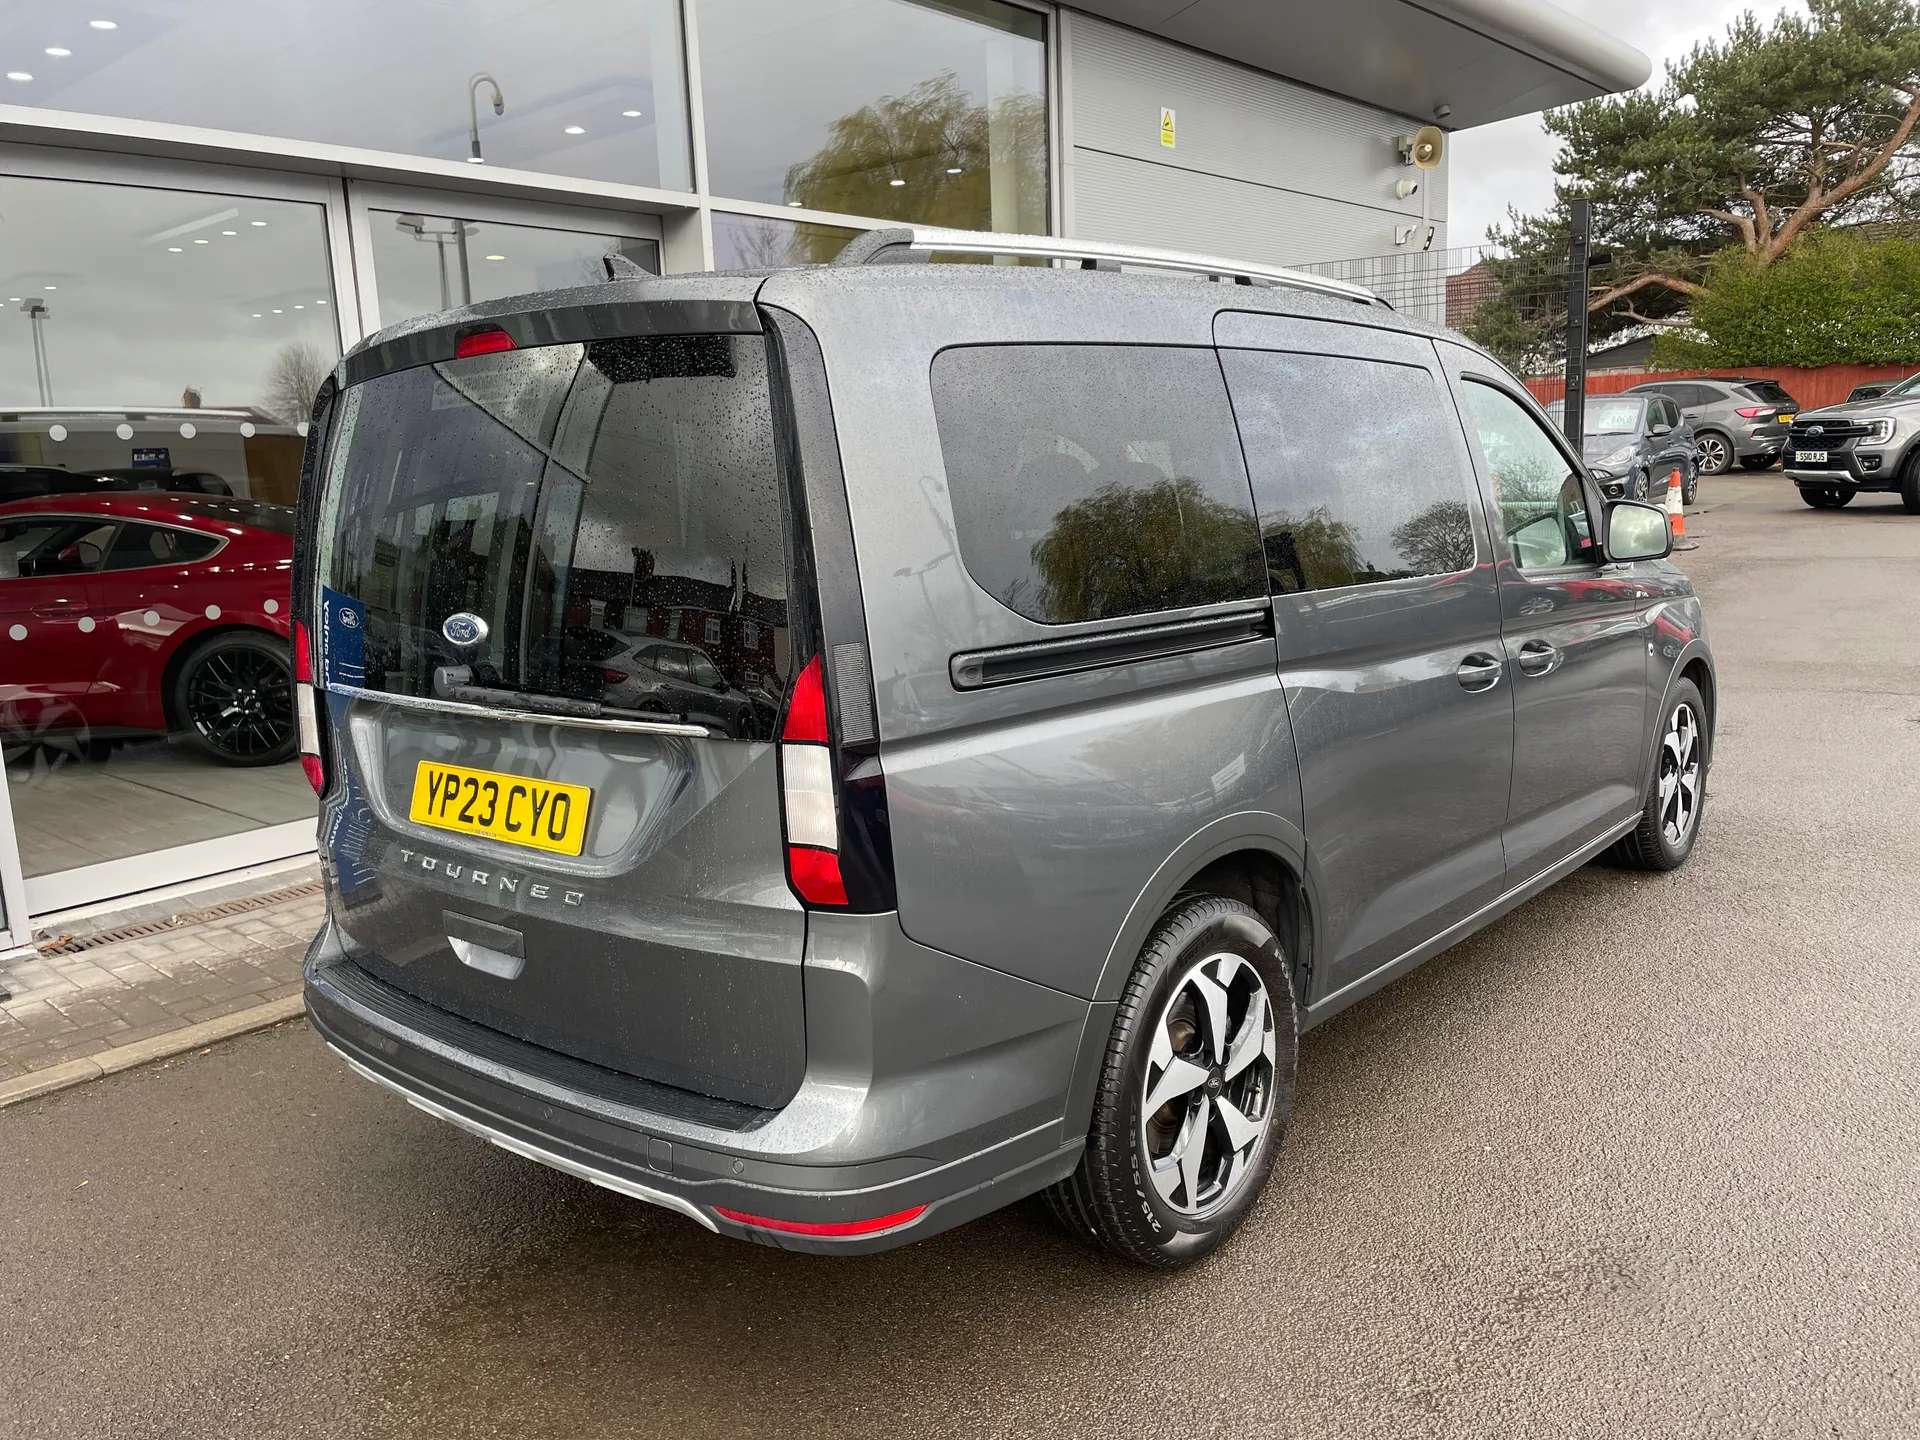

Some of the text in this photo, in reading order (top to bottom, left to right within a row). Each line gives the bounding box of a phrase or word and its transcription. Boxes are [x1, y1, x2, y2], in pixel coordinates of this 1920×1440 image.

[427, 770, 571, 842] YP23 CYO
[400, 849, 584, 906] TOURNEO
